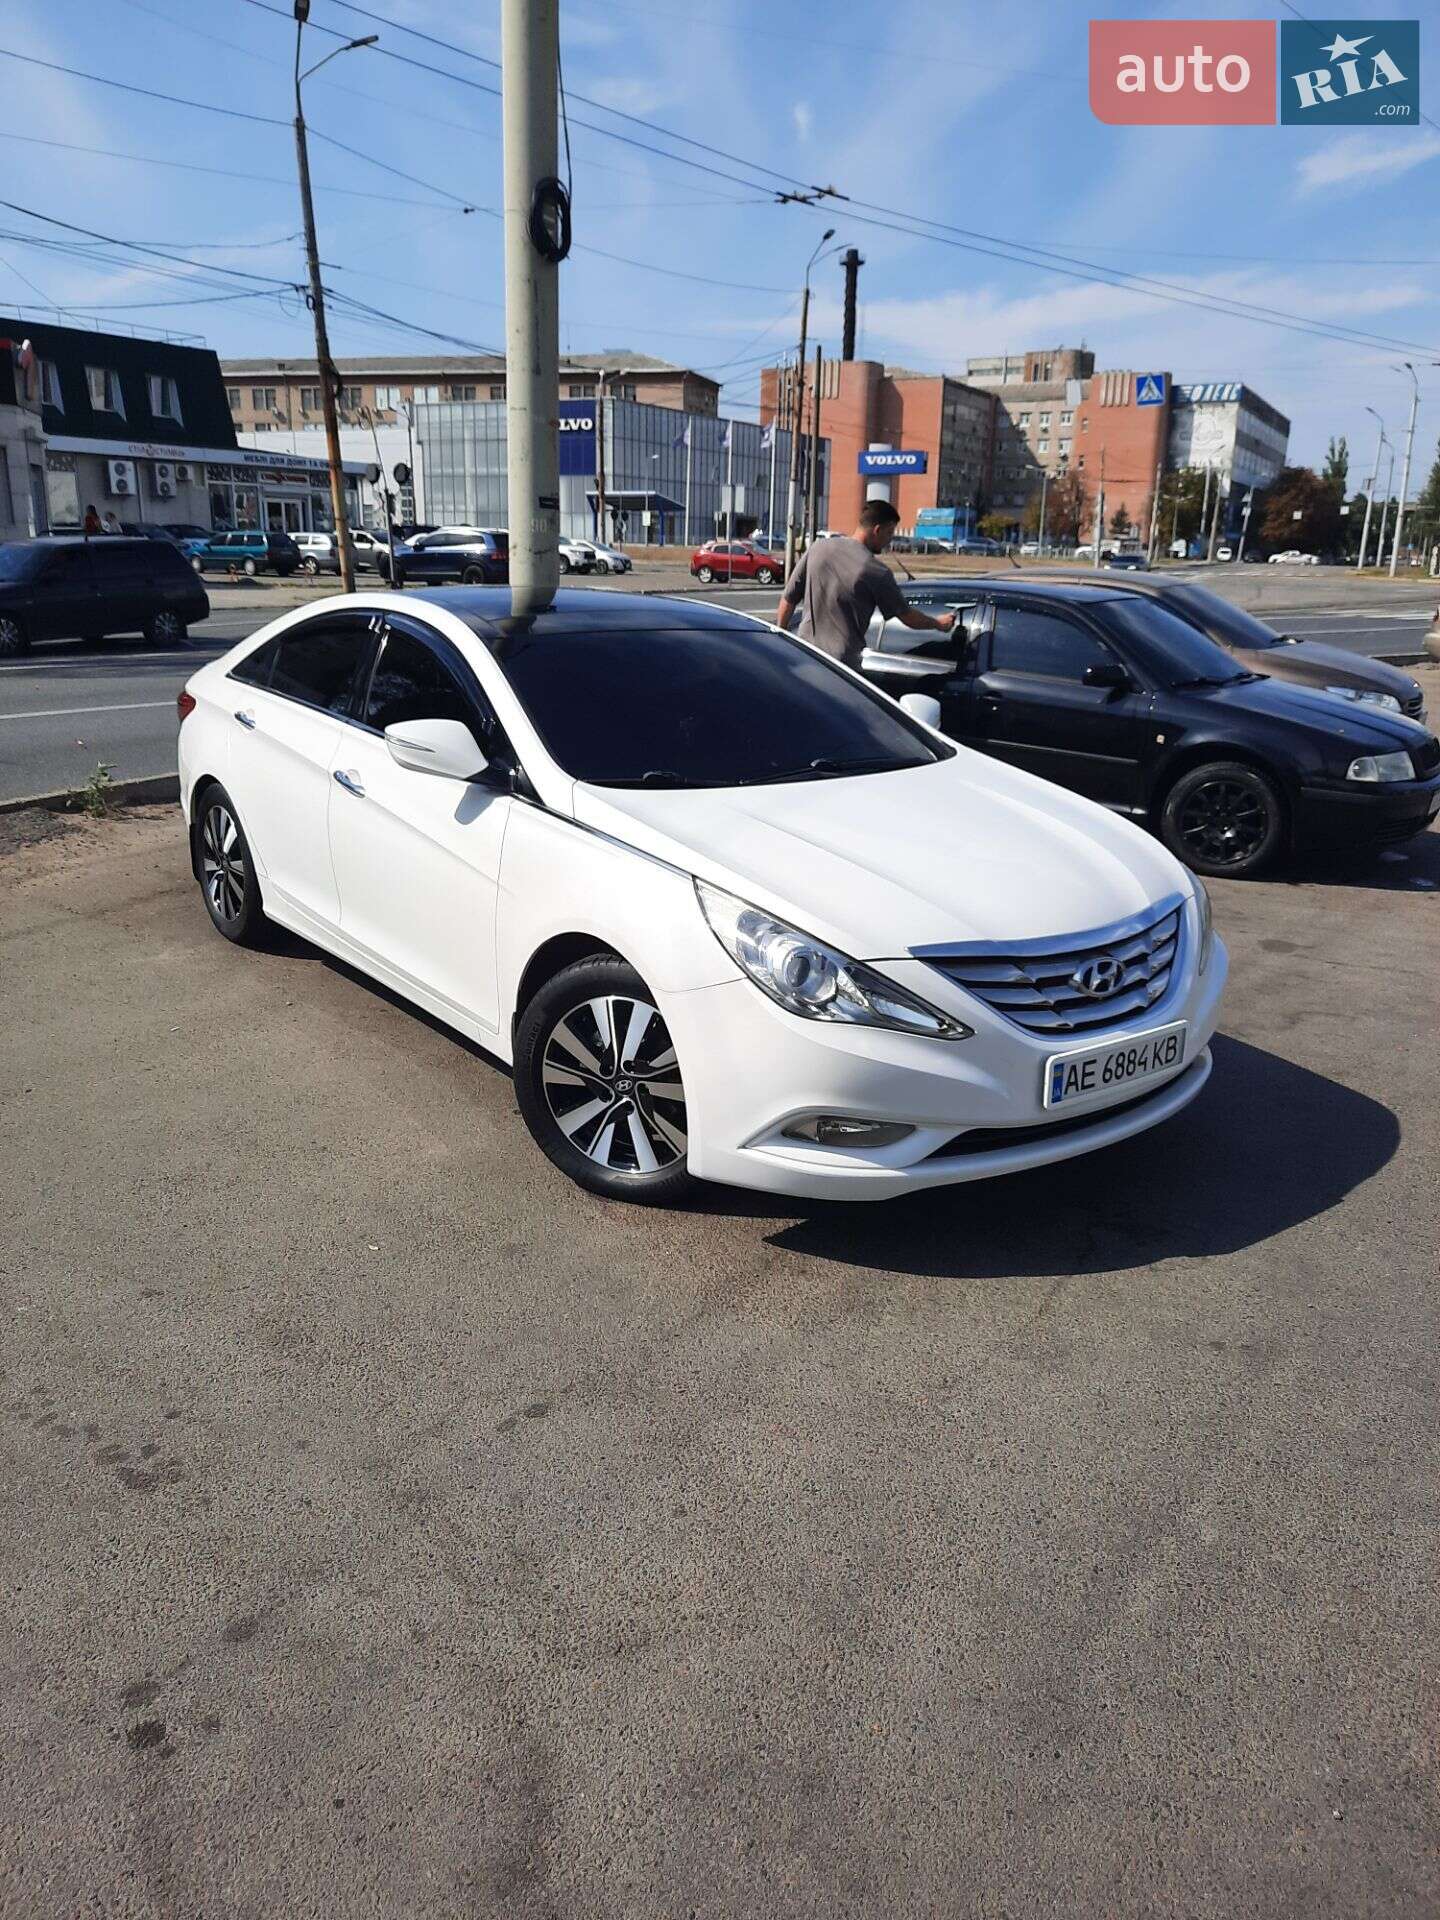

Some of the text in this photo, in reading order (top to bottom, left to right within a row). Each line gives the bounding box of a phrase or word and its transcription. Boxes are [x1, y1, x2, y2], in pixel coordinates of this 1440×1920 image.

[558, 418, 593, 431] LVO
[864, 454, 917, 465] VOLVO
[1064, 1035, 1178, 1095] AE 6884 KB
